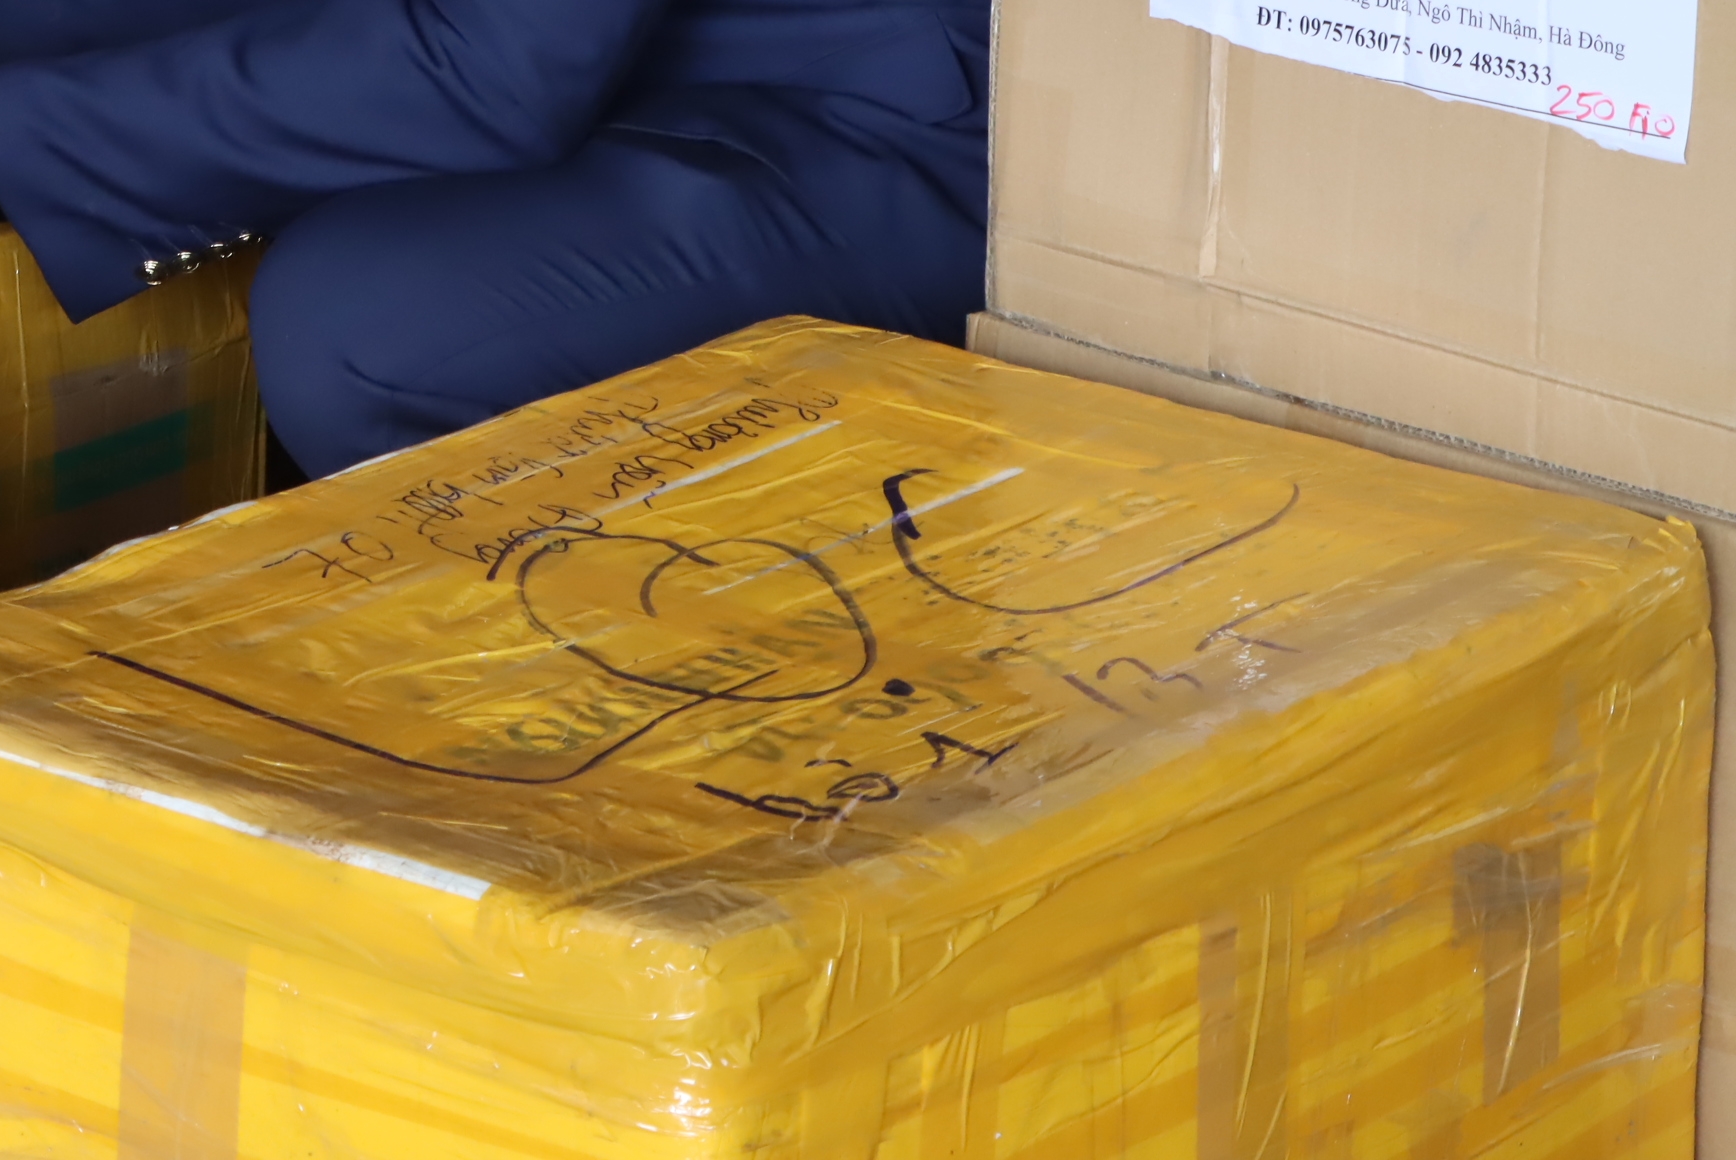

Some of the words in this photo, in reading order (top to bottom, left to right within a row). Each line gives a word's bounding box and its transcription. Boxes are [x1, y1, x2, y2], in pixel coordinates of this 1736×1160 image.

[1257, 6, 1292, 32] ĐT:
[1300, 16, 1410, 55] 0975763075
[1429, 43, 1465, 68] 092
[1470, 52, 1551, 85] 4835333
[1418, 0, 1450, 24] Ngô
[1457, 7, 1482, 28] Thì
[1489, 14, 1544, 43] Nhậm,
[1550, 26, 1571, 46] Hà
[1579, 31, 1624, 60] Đông
[1549, 84, 1616, 122] 250
